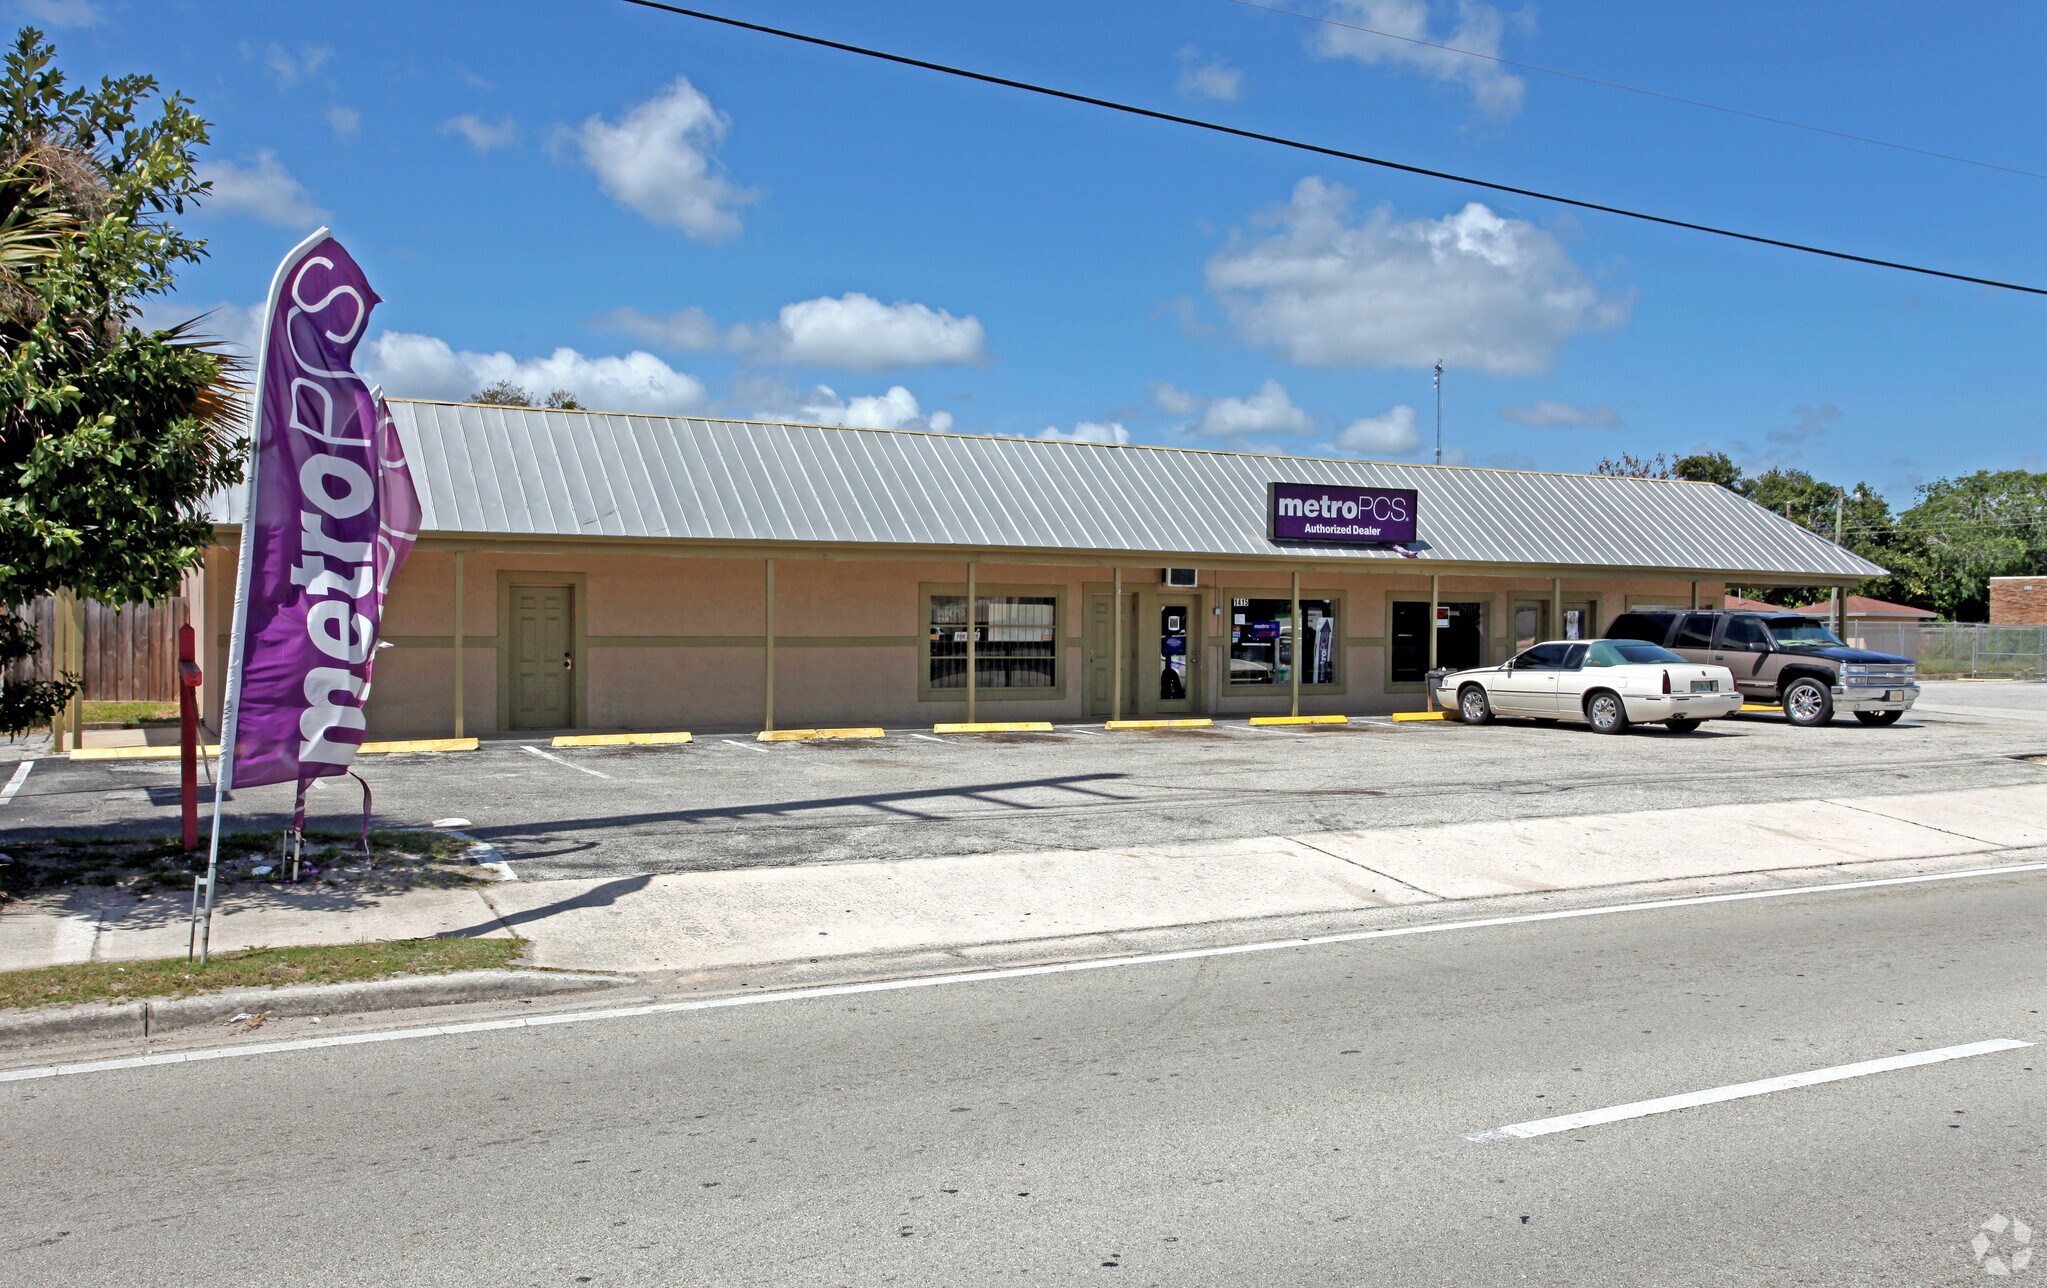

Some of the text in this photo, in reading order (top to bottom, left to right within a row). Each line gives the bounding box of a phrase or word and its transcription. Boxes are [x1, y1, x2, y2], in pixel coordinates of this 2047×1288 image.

[286, 255, 375, 766] metroPCS
[1278, 495, 1407, 522] metroPCS
[1304, 523, 1382, 536] Authorized Dealer
